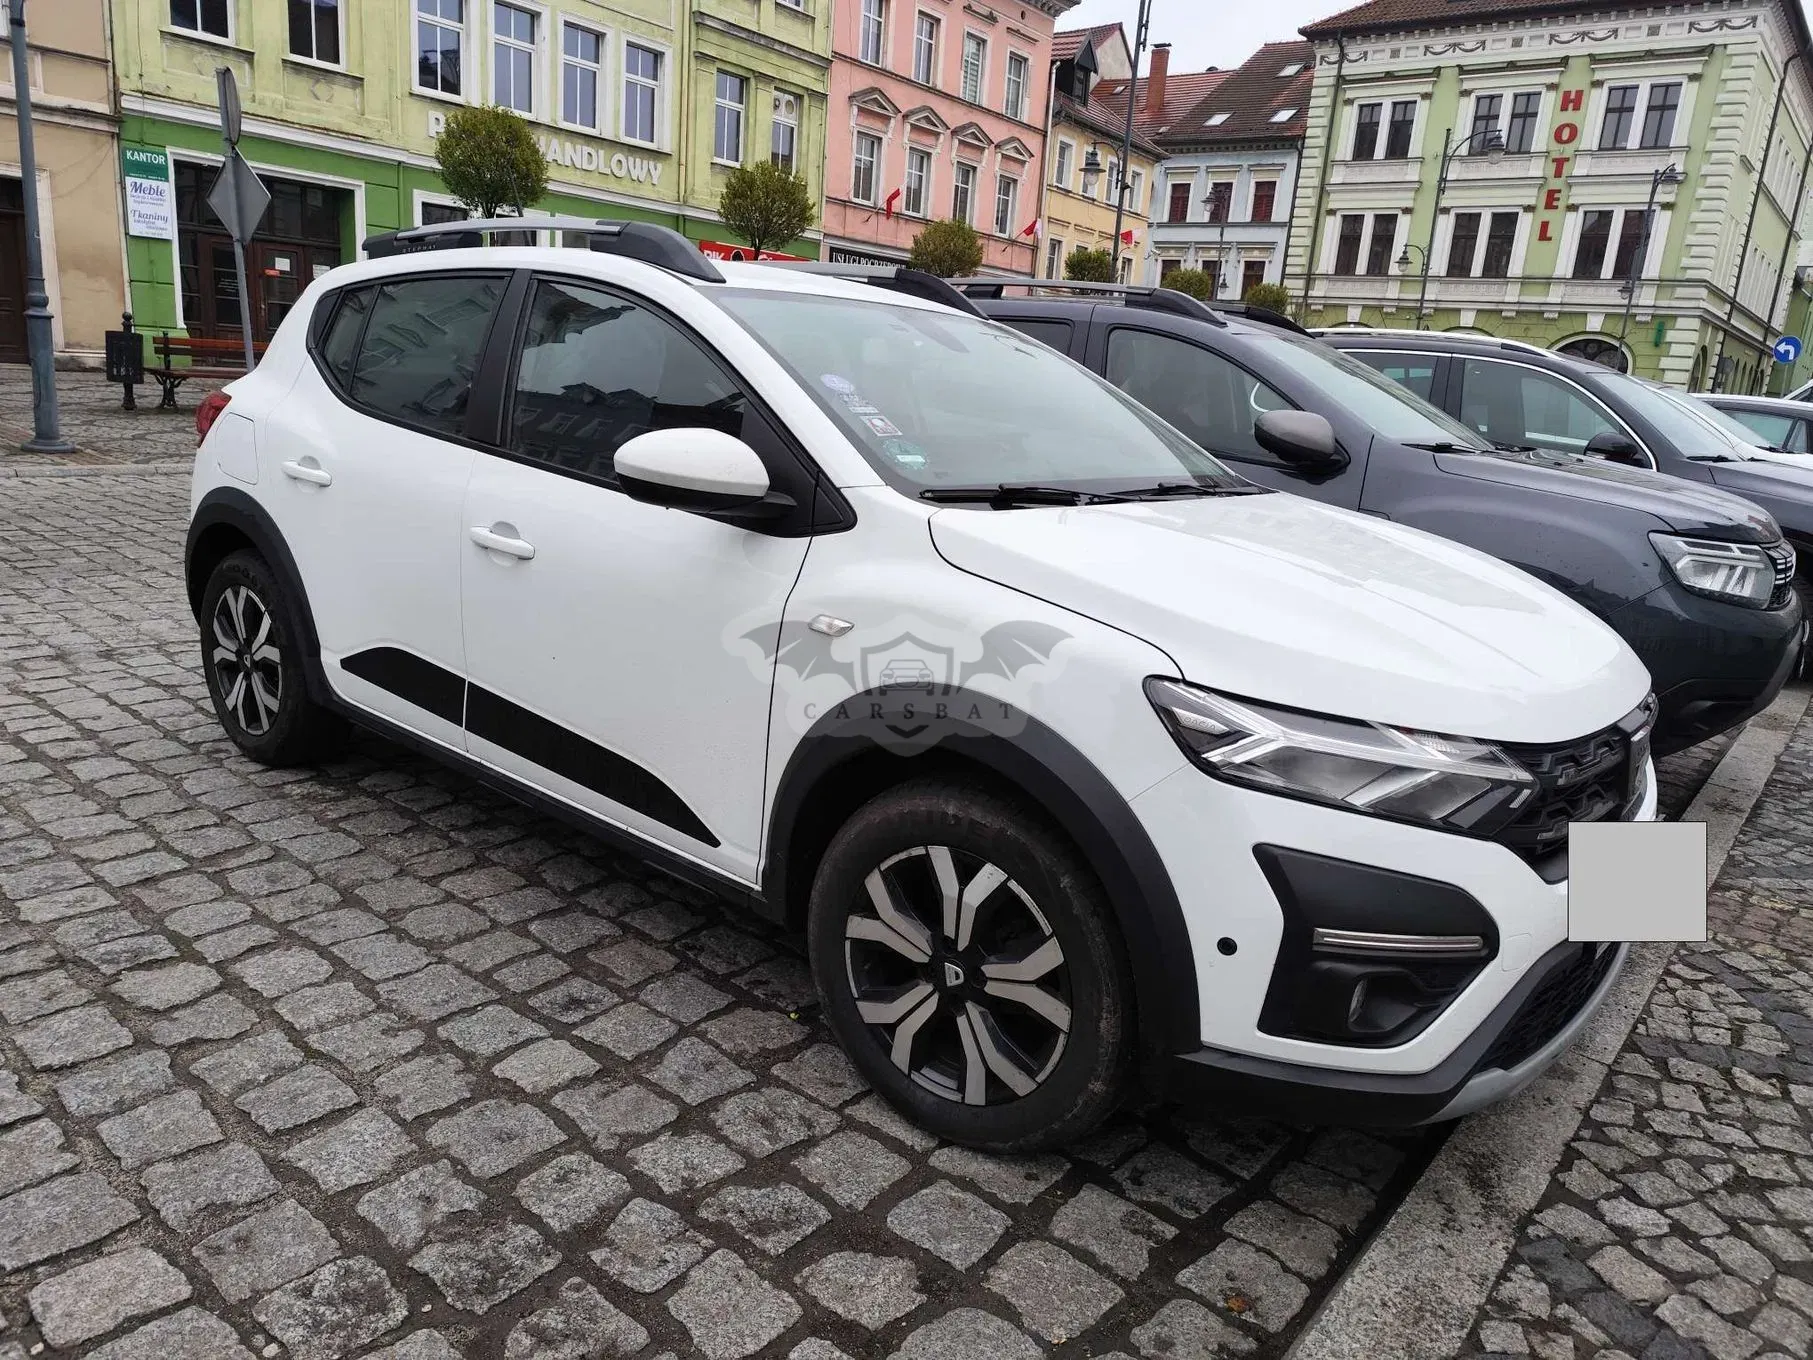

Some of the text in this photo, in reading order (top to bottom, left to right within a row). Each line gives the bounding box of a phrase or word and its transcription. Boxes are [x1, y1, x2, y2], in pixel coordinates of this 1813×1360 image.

[126, 150, 166, 165] KANTOR
[1538, 89, 1584, 242] HOTEL
[130, 181, 167, 197] Meble
[130, 209, 168, 224] Tkaniny
